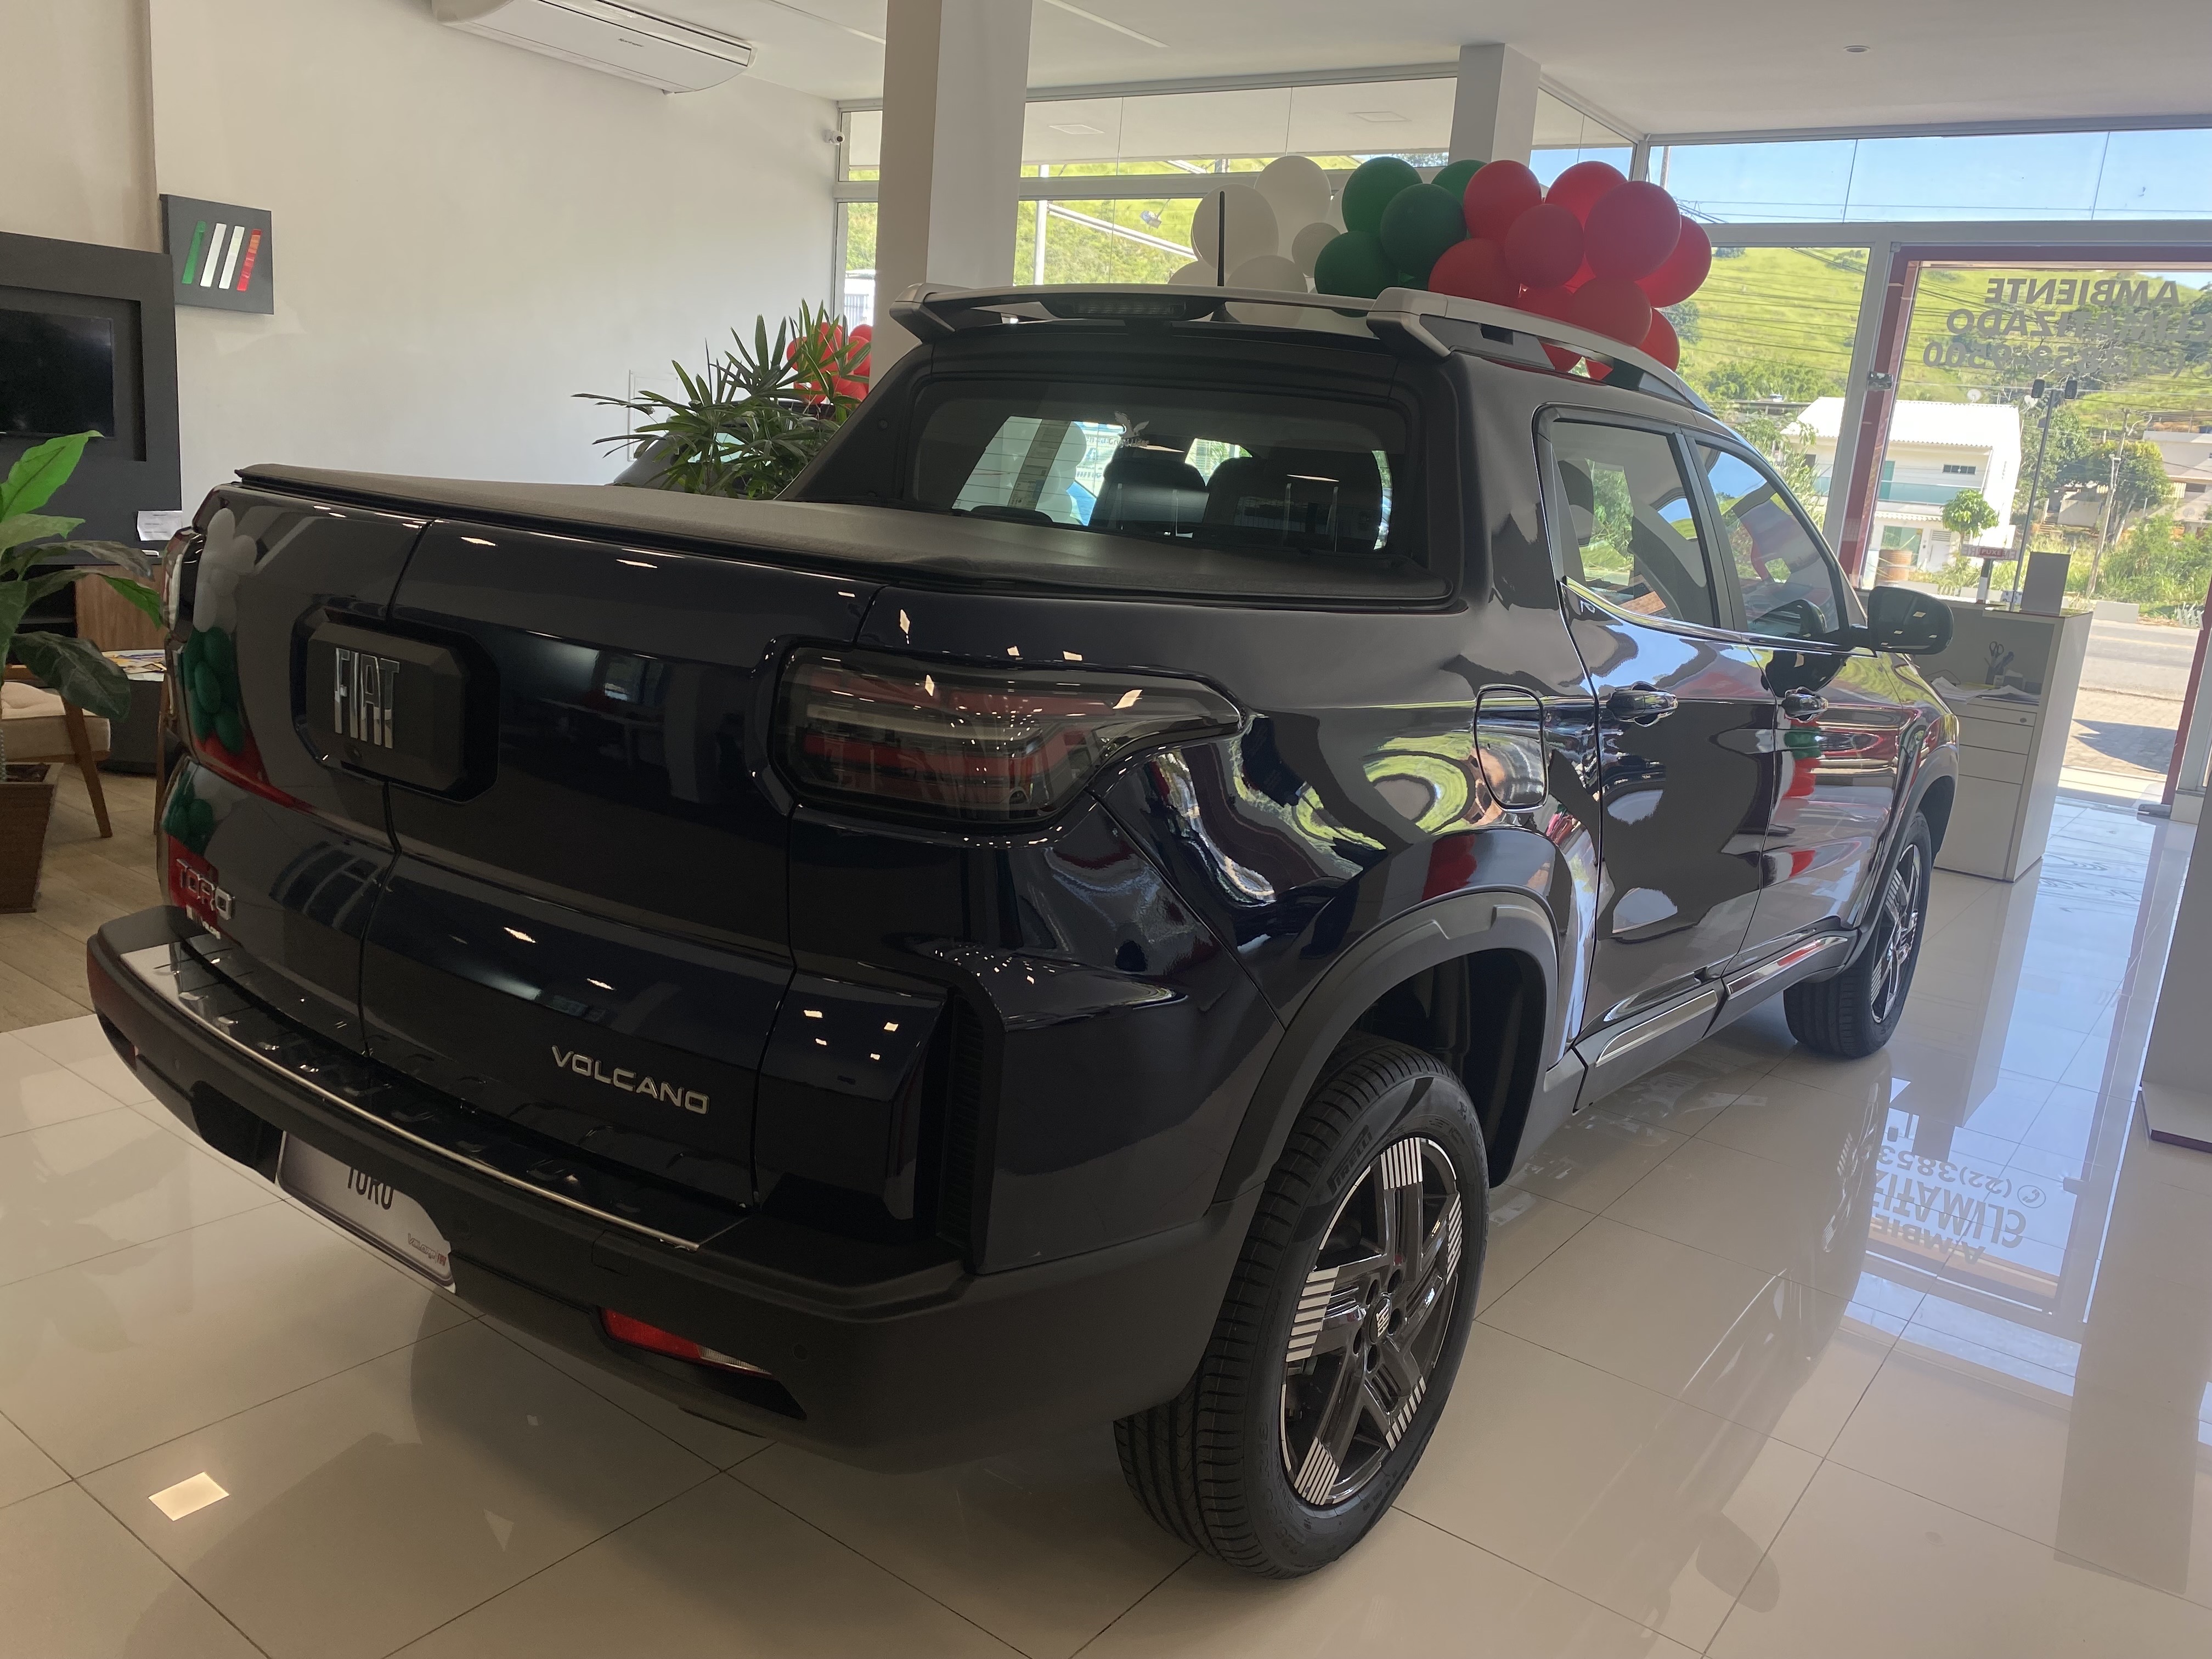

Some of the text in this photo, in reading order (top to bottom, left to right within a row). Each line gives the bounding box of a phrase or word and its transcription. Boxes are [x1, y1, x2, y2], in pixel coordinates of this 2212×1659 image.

[335, 647, 400, 749] FIAT
[176, 859, 233, 921] TORO
[551, 1045, 710, 1115] VOLCANO
[1327, 1125, 1373, 1197] PIRELLI
[1376, 1304, 1390, 1338] FIAT
